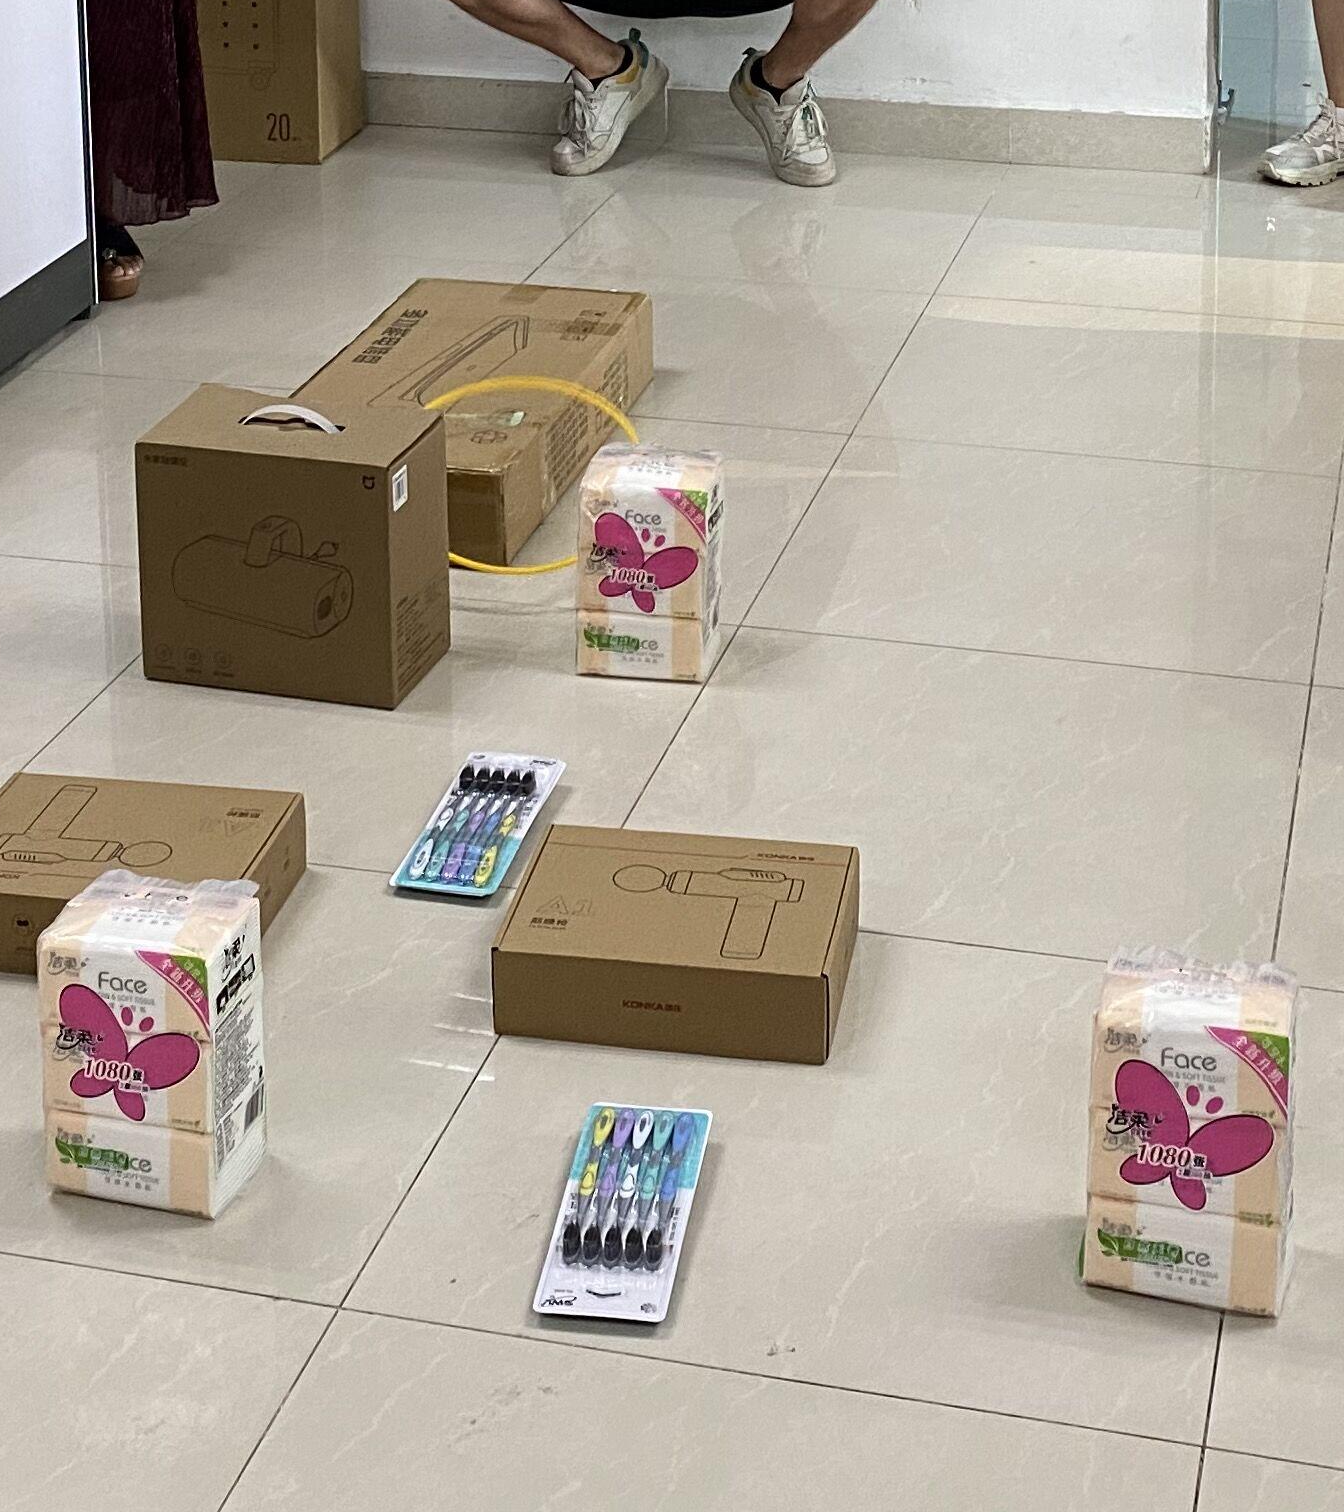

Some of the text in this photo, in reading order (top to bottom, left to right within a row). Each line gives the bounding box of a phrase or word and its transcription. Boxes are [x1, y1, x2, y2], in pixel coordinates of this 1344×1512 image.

[266, 112, 291, 141] 20
[625, 509, 662, 525] Face
[98, 971, 147, 994] Face
[1160, 1047, 1217, 1072] Face
